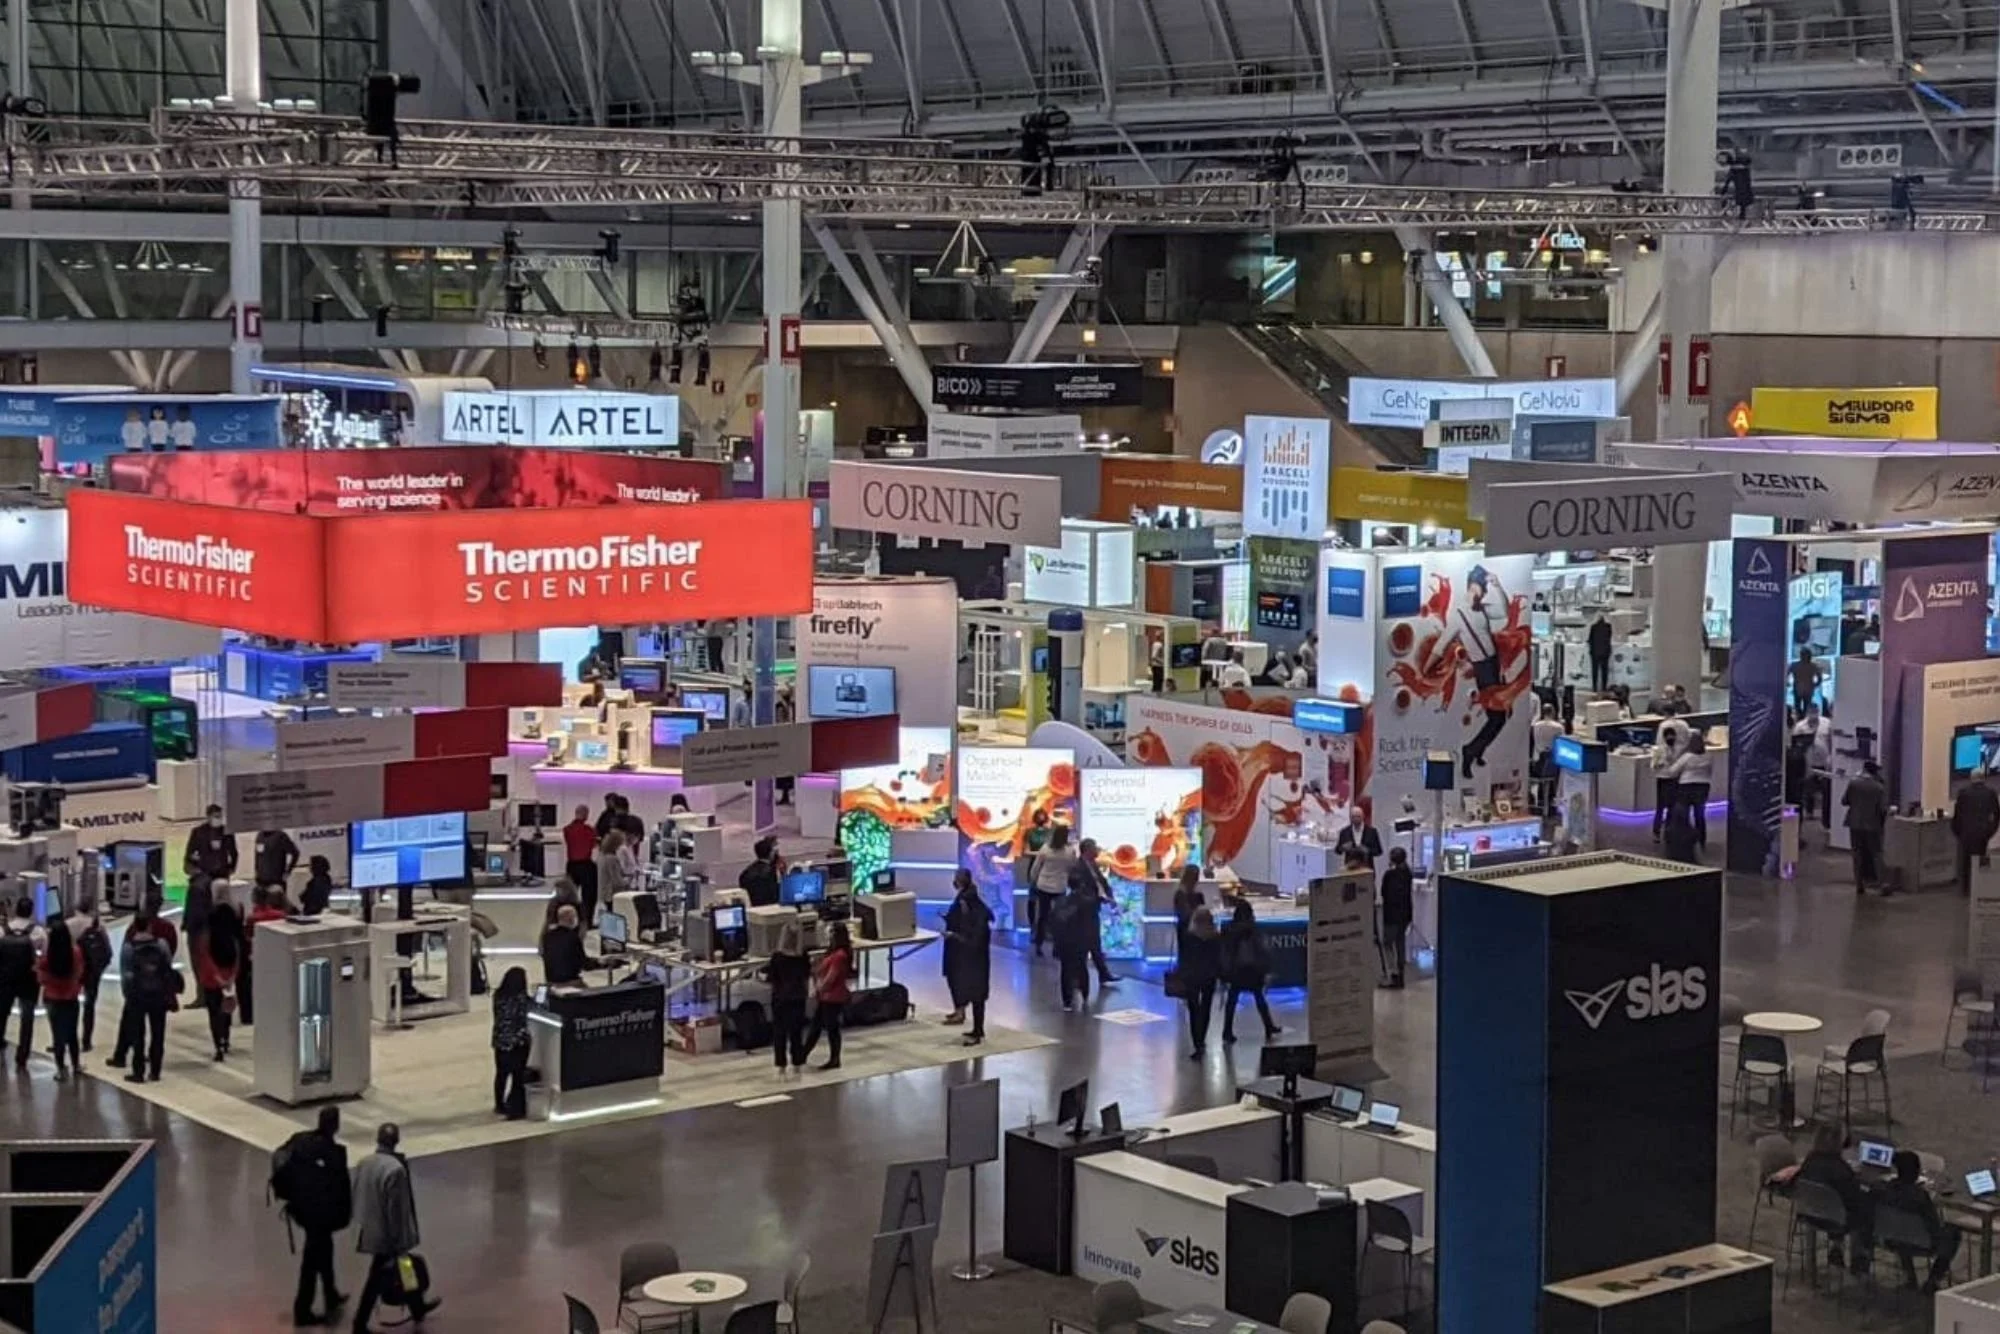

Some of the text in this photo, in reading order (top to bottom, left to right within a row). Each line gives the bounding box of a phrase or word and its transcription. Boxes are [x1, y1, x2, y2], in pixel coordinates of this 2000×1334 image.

[1383, 389, 1428, 410] GeNo
[452, 404, 523, 434] ARTEL
[549, 408, 663, 435] ARTEL
[1441, 425, 1500, 443] INTEGRA
[337, 472, 463, 490] The world leader in
[616, 482, 634, 498] The
[636, 486, 660, 500] world
[662, 487, 691, 503] leader
[1742, 472, 1828, 491] AZENTA
[1949, 474, 2000, 491] AZEN
[337, 494, 441, 509] serving science
[863, 481, 1021, 530] CORNING
[1528, 491, 1696, 539] CORNING
[0, 561, 63, 599] MI
[128, 562, 252, 601] SCIENTIFIC
[466, 571, 697, 604] SCIENTIFIC
[1739, 580, 1780, 594] AZENTA
[1927, 581, 1978, 599] AZENTA
[18, 602, 73, 617] Leaders
[1625, 962, 1706, 1019] slas
[1084, 1244, 1142, 1280] Innovate
[1170, 1235, 1219, 1276] slas
